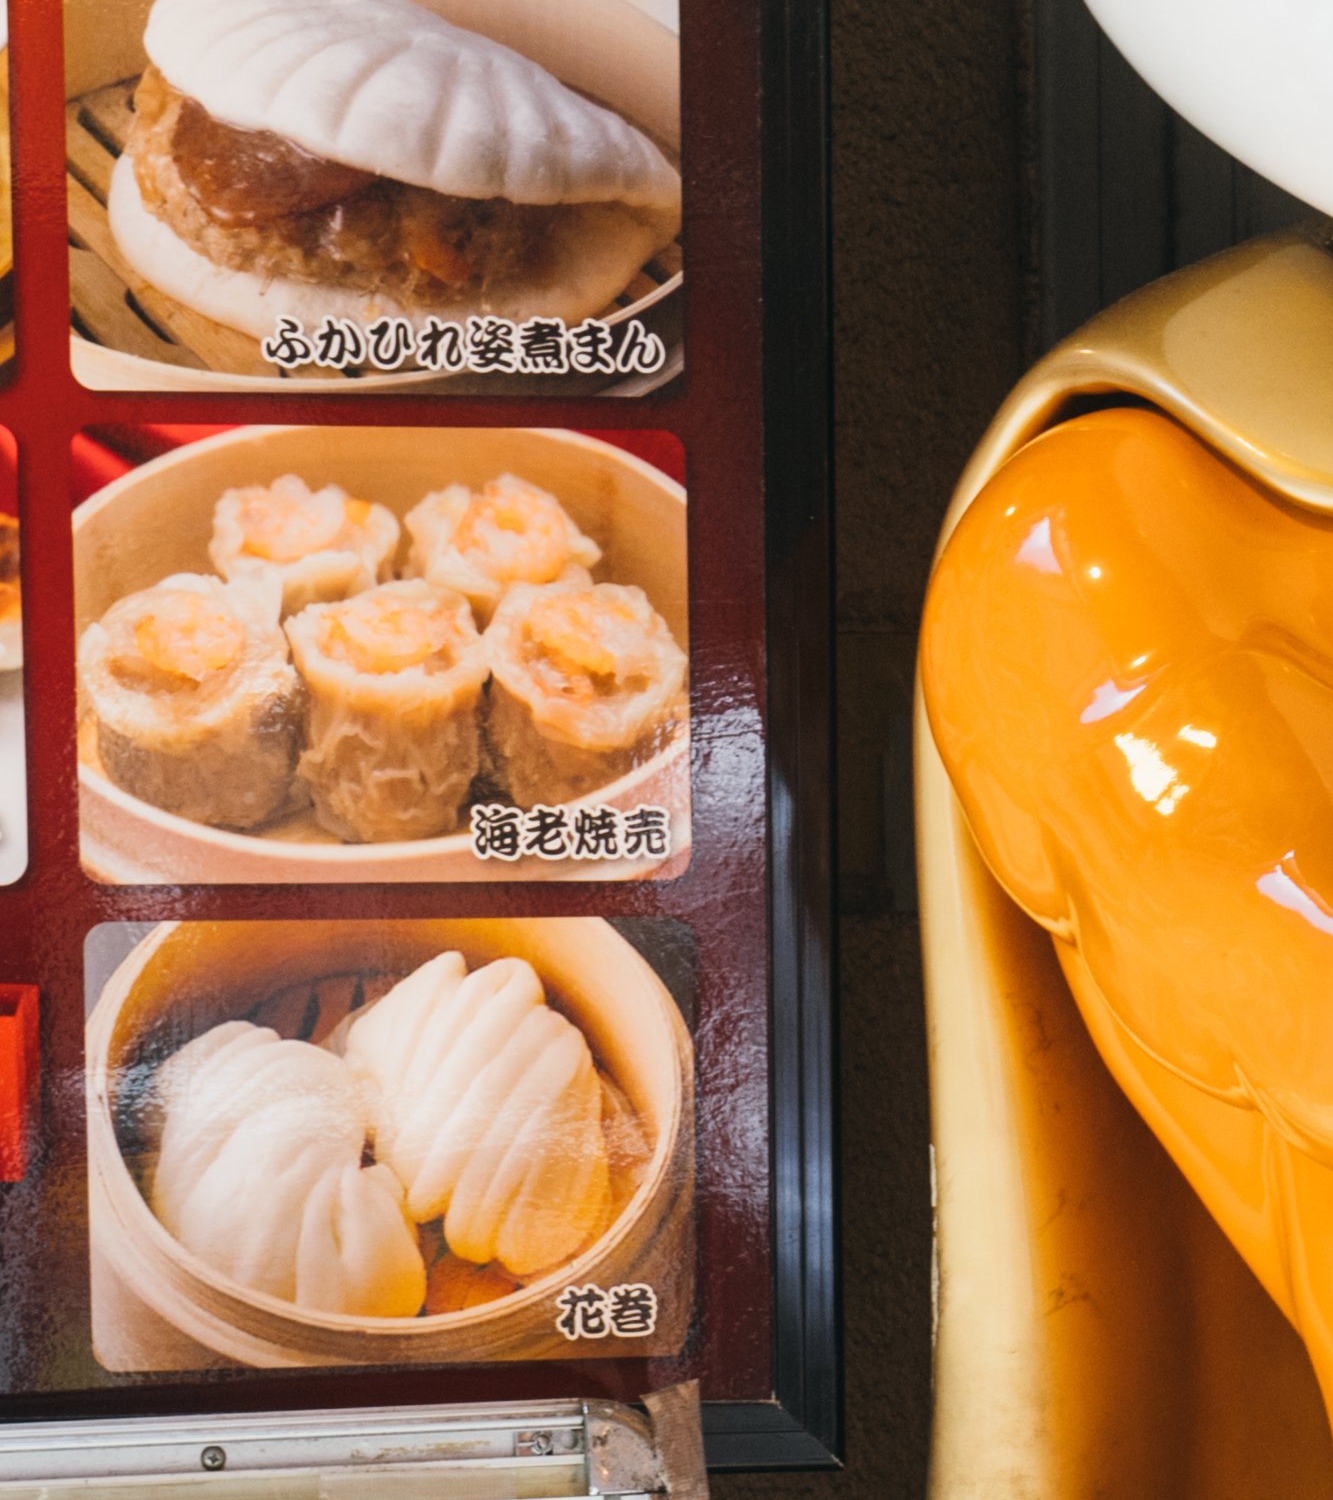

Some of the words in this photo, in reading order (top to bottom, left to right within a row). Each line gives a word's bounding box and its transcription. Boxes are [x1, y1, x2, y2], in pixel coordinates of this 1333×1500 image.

[264, 316, 666, 374] ふかひれ姿煮まん
[474, 806, 670, 860] 海老焼売
[559, 1287, 656, 1338] 花巻
